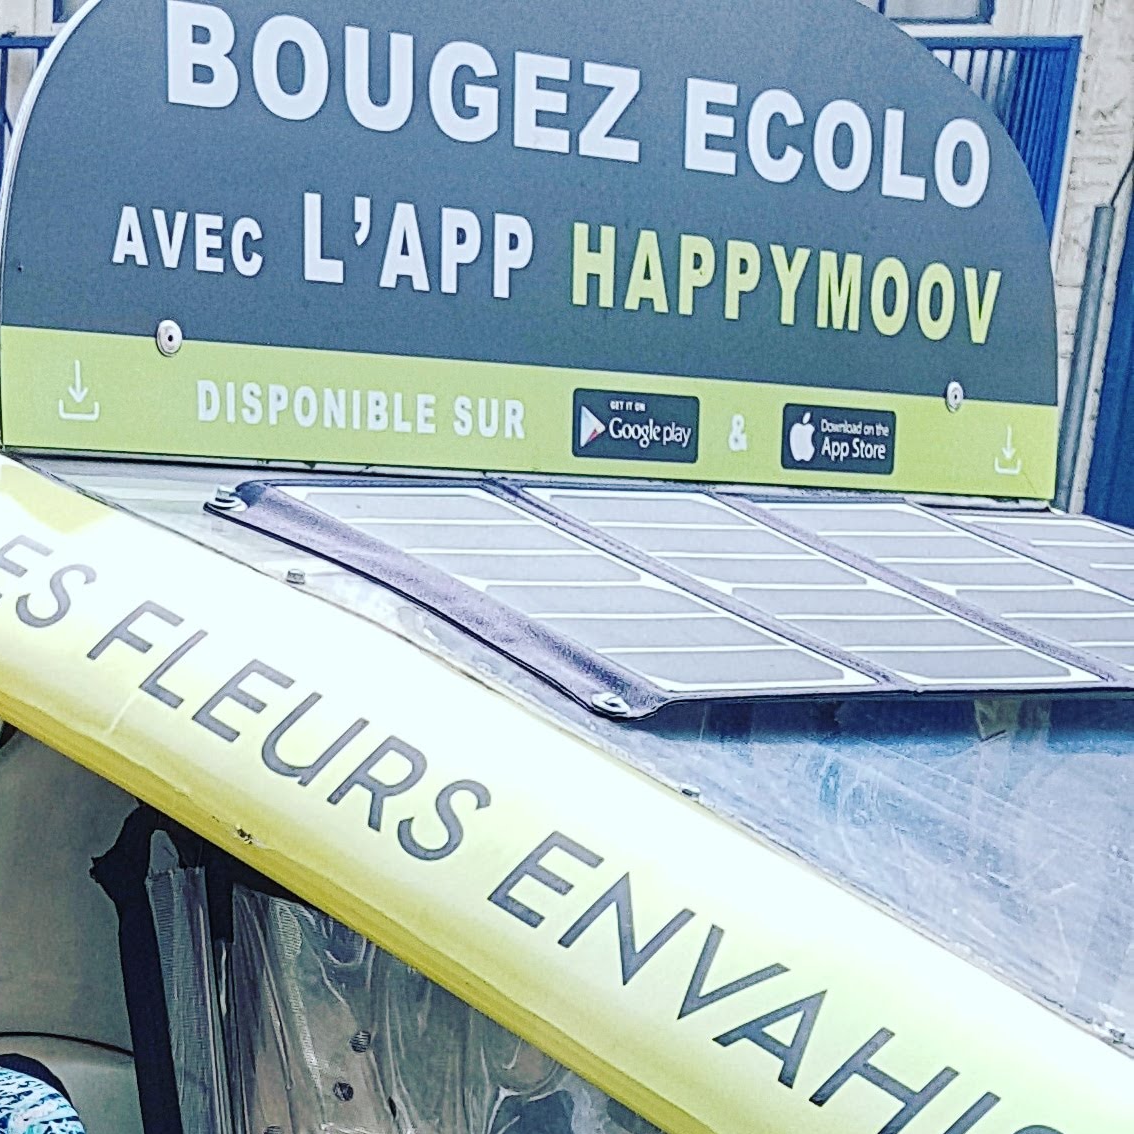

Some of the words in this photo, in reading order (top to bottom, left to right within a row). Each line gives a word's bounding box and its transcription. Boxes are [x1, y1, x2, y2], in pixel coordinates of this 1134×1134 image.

[167, 0, 641, 164] BOUGEZ
[684, 76, 991, 209] ECOLO
[112, 205, 264, 278] AVEC
[571, 221, 1002, 345] HAPPYMOOV
[196, 379, 437, 434] DISPONIBLE
[452, 395, 526, 440] SUR
[608, 416, 662, 449] Google
[662, 421, 692, 448] play
[728, 413, 747, 451] &
[820, 418, 863, 435] Download
[863, 424, 875, 436] on
[875, 422, 890, 437] the
[820, 436, 850, 462] App
[851, 437, 887, 460] Store
[86, 599, 491, 861] FLEURS
